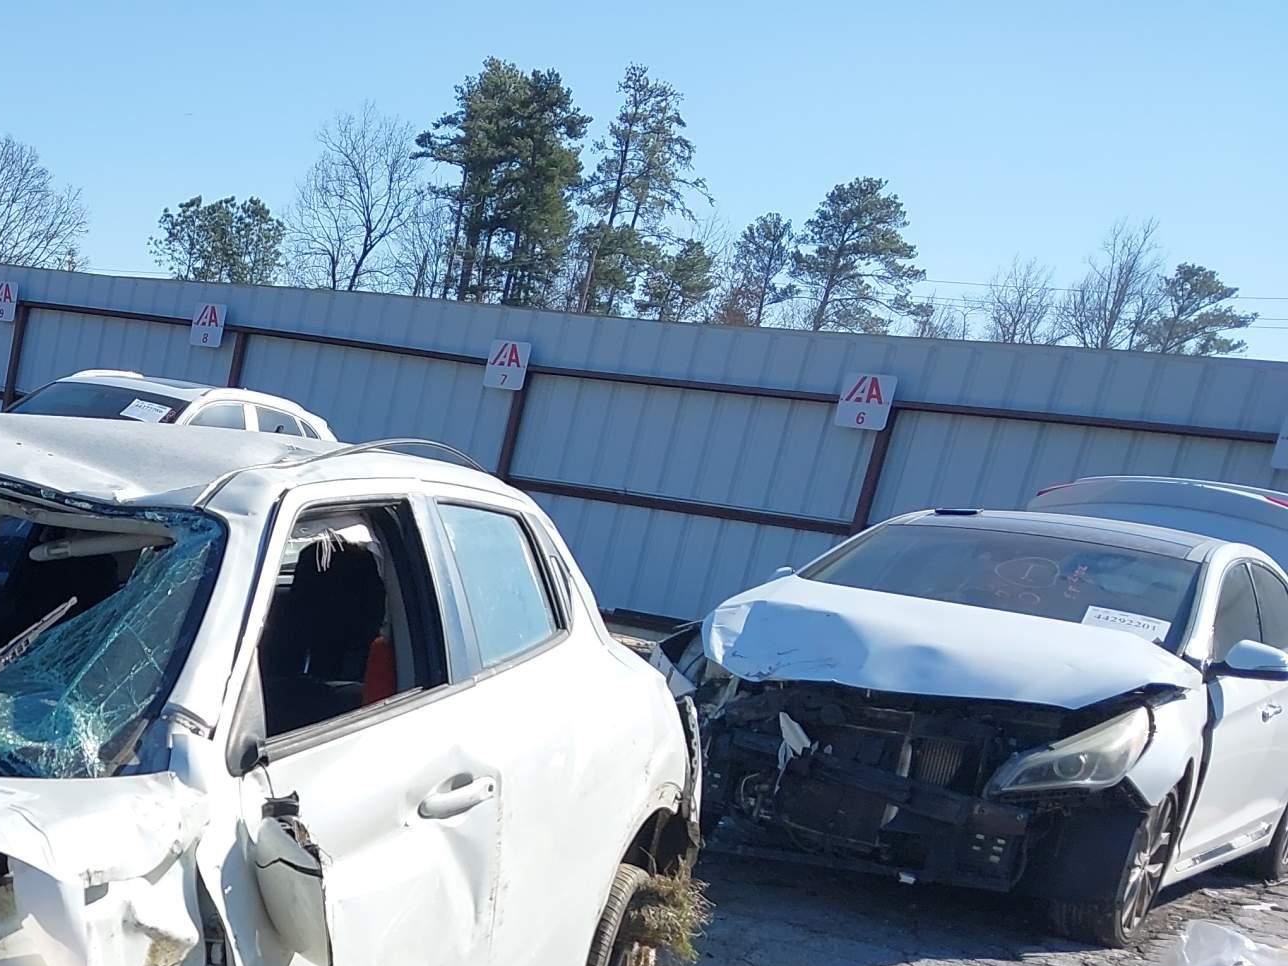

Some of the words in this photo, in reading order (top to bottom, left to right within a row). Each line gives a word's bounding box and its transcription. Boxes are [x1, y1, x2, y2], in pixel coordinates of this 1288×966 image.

[0, 308, 5, 318] 9
[201, 332, 209, 343] 8
[500, 374, 508, 386] 7
[855, 411, 866, 425] 6
[1093, 612, 1158, 632] 44292201
